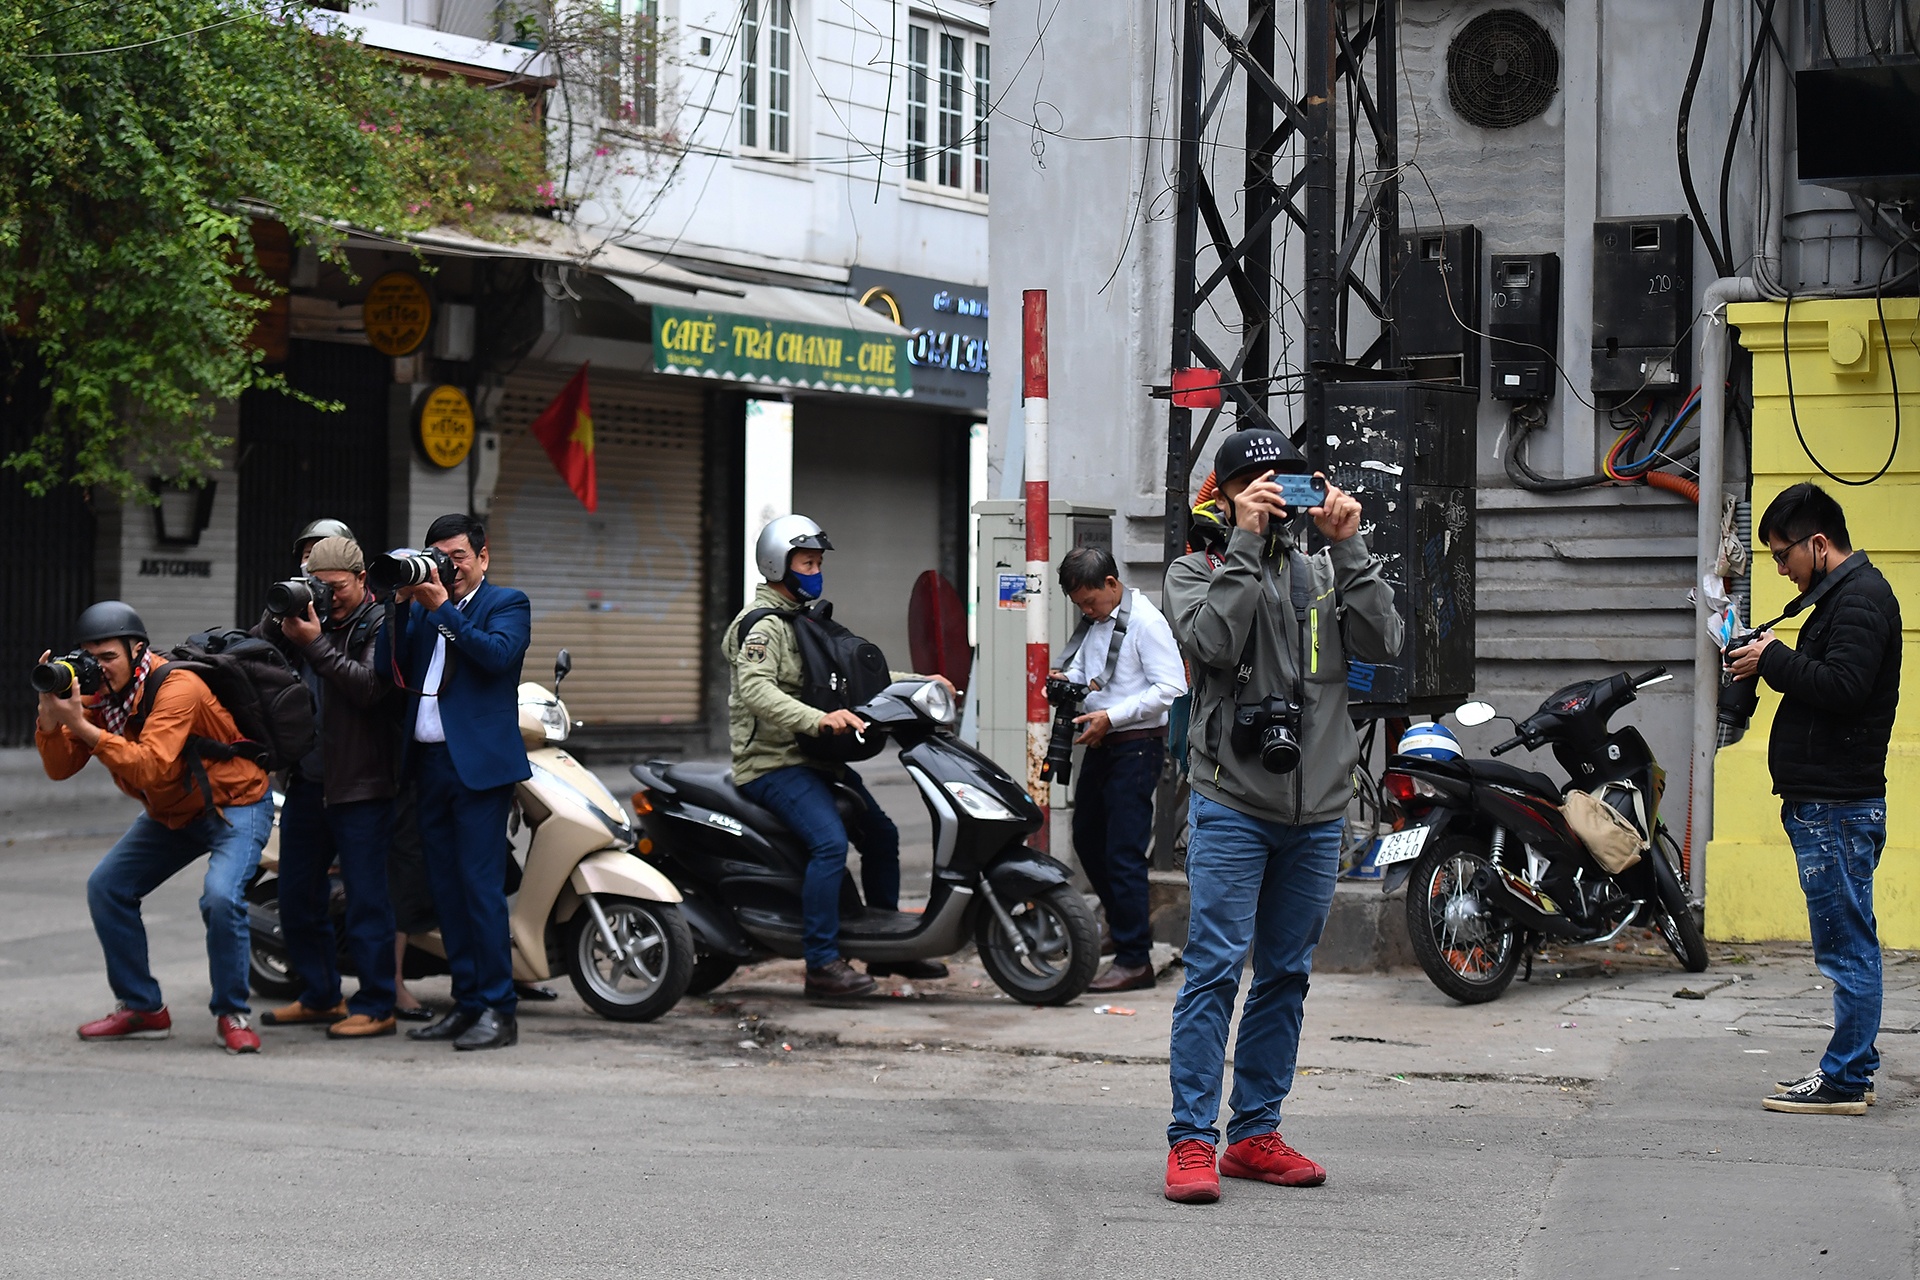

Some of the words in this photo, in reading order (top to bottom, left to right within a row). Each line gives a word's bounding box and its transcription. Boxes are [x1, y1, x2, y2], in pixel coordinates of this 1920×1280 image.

[1648, 274, 1672, 294] 220
[661, 313, 717, 354] CAFÉ
[733, 321, 773, 360] TRÀ
[776, 331, 843, 368] CHANH
[858, 337, 896, 374] CHÈ
[1245, 446, 1281, 458] MILLS
[1250, 437, 1272, 447] LES
[1387, 829, 1421, 849] 29-C1
[1377, 843, 1419, 864] 856.40
